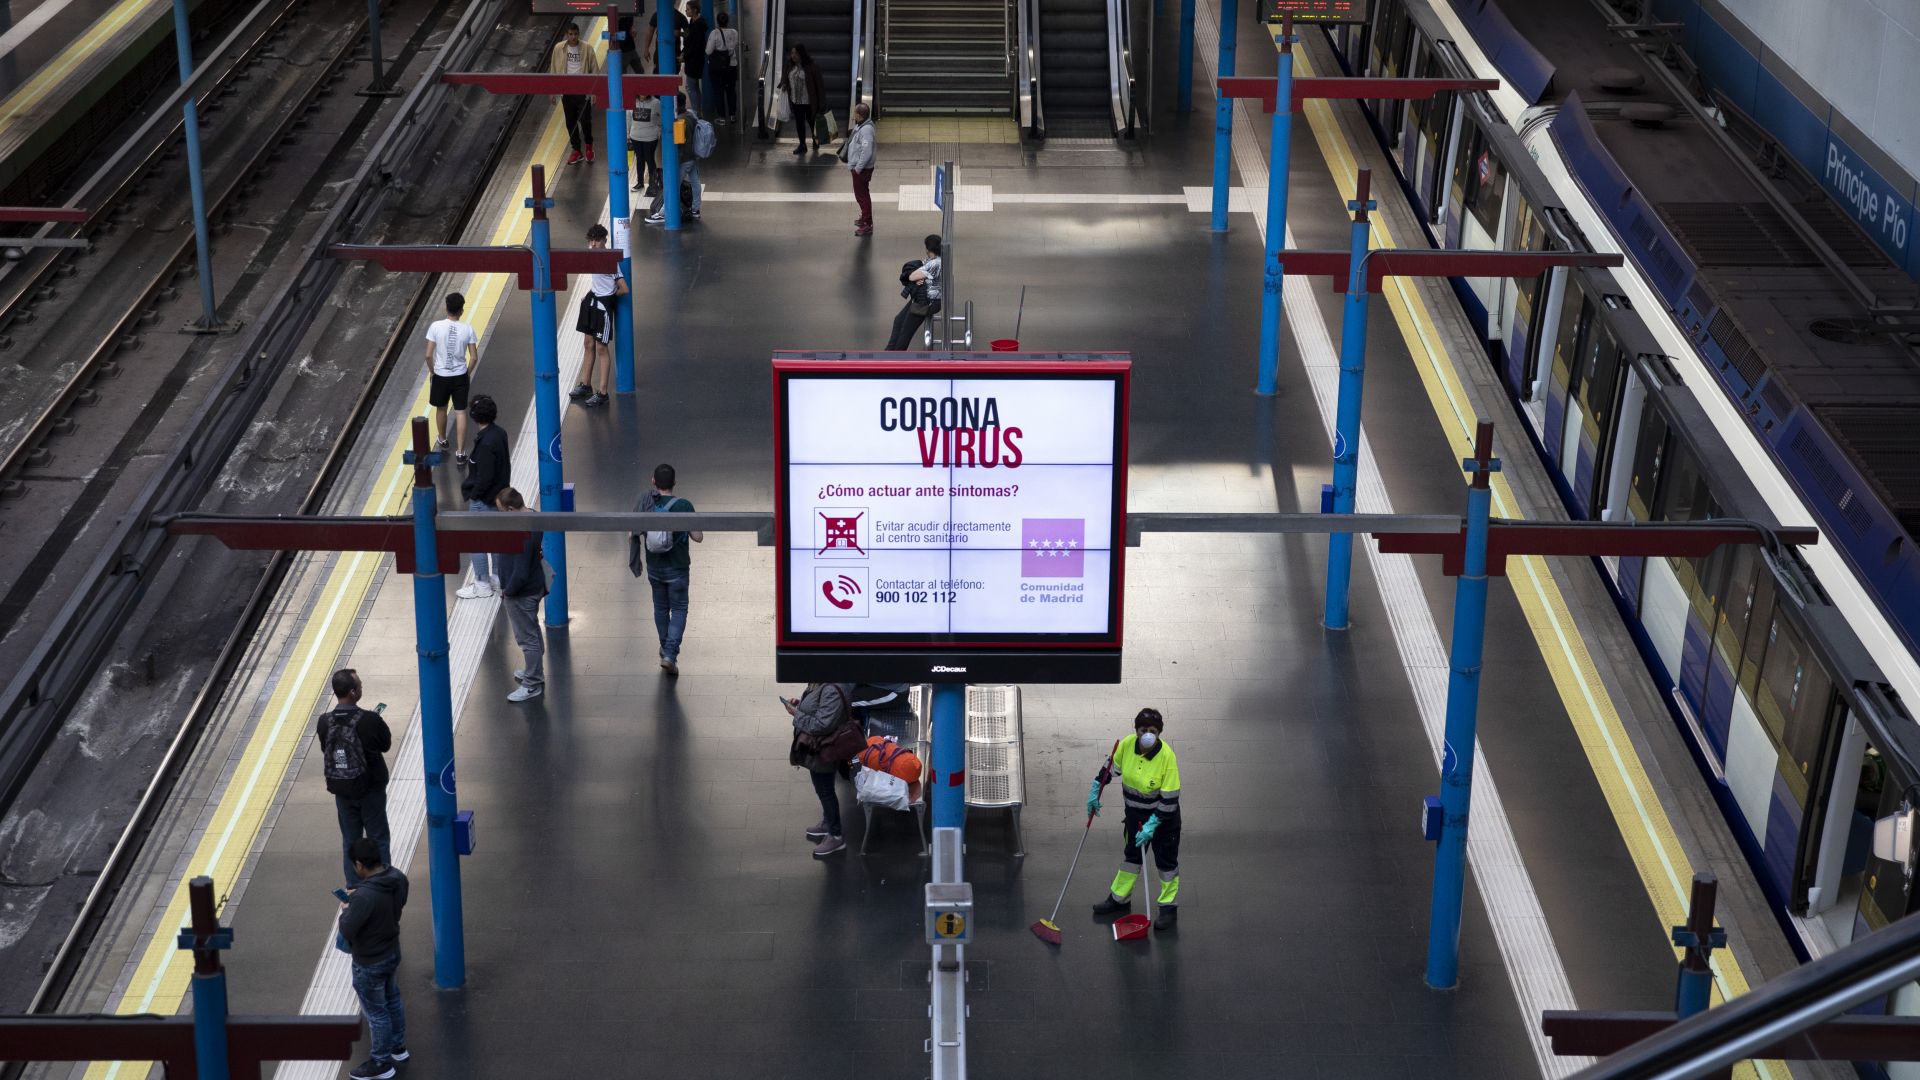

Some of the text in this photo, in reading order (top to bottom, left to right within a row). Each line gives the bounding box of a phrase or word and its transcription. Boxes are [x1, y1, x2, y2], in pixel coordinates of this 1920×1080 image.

[1826, 142, 1906, 249] Príncipe Pío
[880, 397, 1000, 432] CORONA
[917, 426, 1023, 469] VIRUS
[818, 484, 1019, 500] ¿Cómo actuar ante síntomas?
[876, 520, 1012, 532] Evitar acudir directamente
[875, 532, 969, 543] al centro sanitario
[875, 578, 985, 590] Contactar al teléfono:
[1020, 582, 1084, 592] Comunidad
[875, 591, 957, 603] 900 102 112
[1020, 593, 1084, 603] de Madrid
[930, 665, 967, 673] JCDecaux
